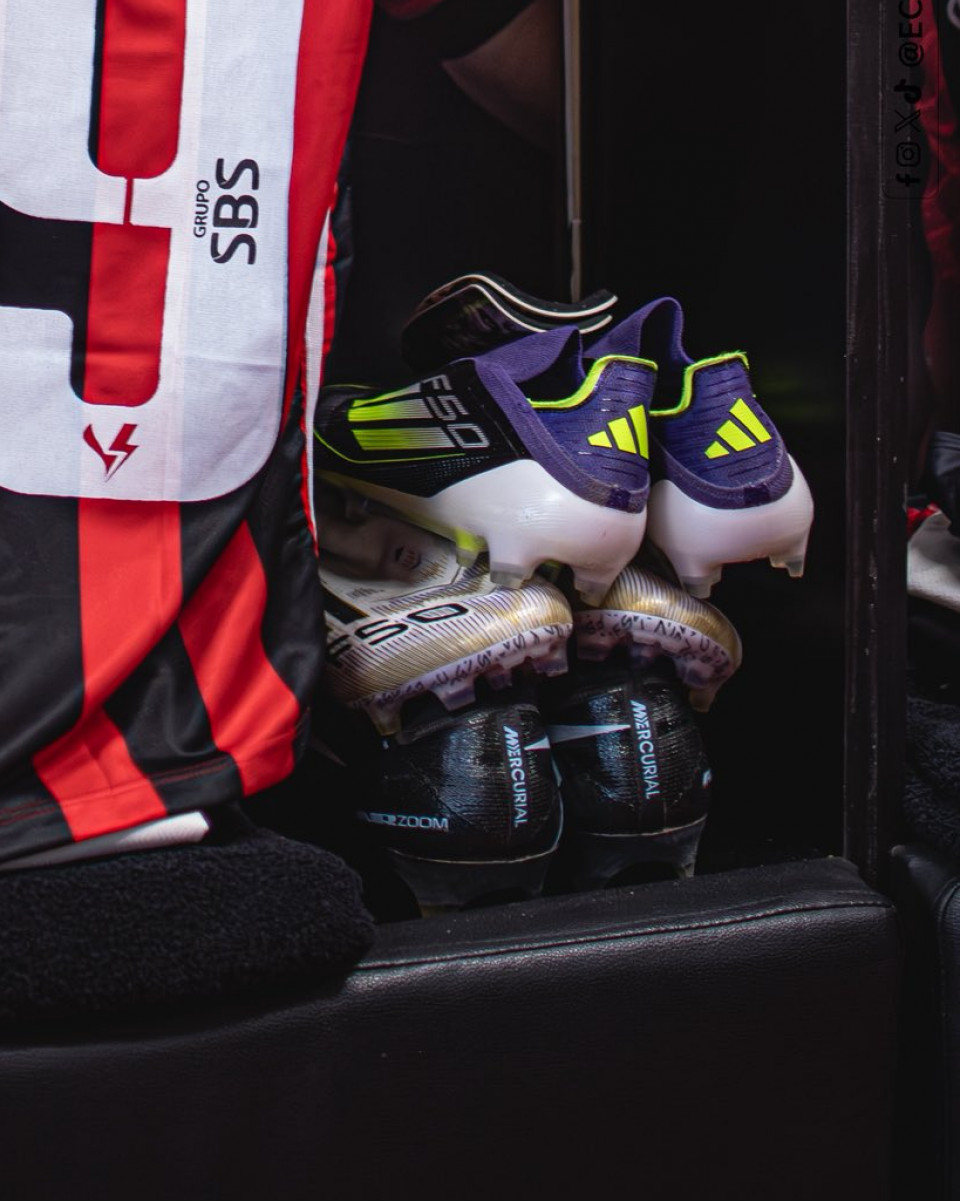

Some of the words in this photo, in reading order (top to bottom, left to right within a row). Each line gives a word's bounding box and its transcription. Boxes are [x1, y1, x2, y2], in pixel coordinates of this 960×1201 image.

[193, 179, 210, 238] GRUPO
[210, 158, 260, 265] SBS
[419, 373, 491, 449] F50
[503, 724, 529, 829] MERCURIAL
[628, 699, 661, 800] MERCURIAL
